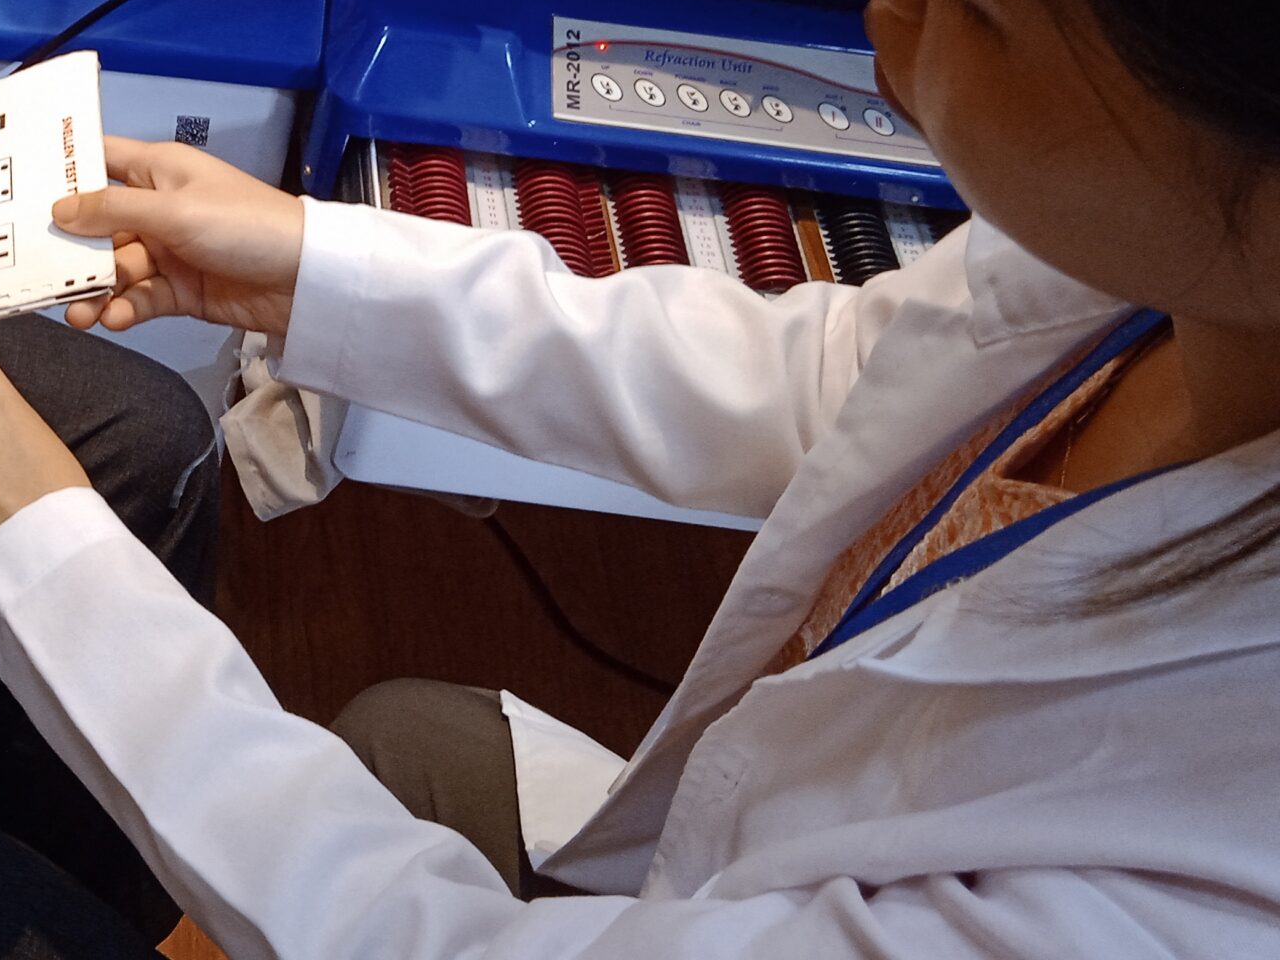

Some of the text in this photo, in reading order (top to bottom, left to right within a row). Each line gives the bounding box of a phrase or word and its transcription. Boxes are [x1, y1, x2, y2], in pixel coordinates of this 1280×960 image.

[566, 29, 581, 110] MR-2012
[644, 49, 752, 74] Refraction Unit
[62, 116, 75, 159] SNELLEN
[65, 160, 77, 184] TEST
